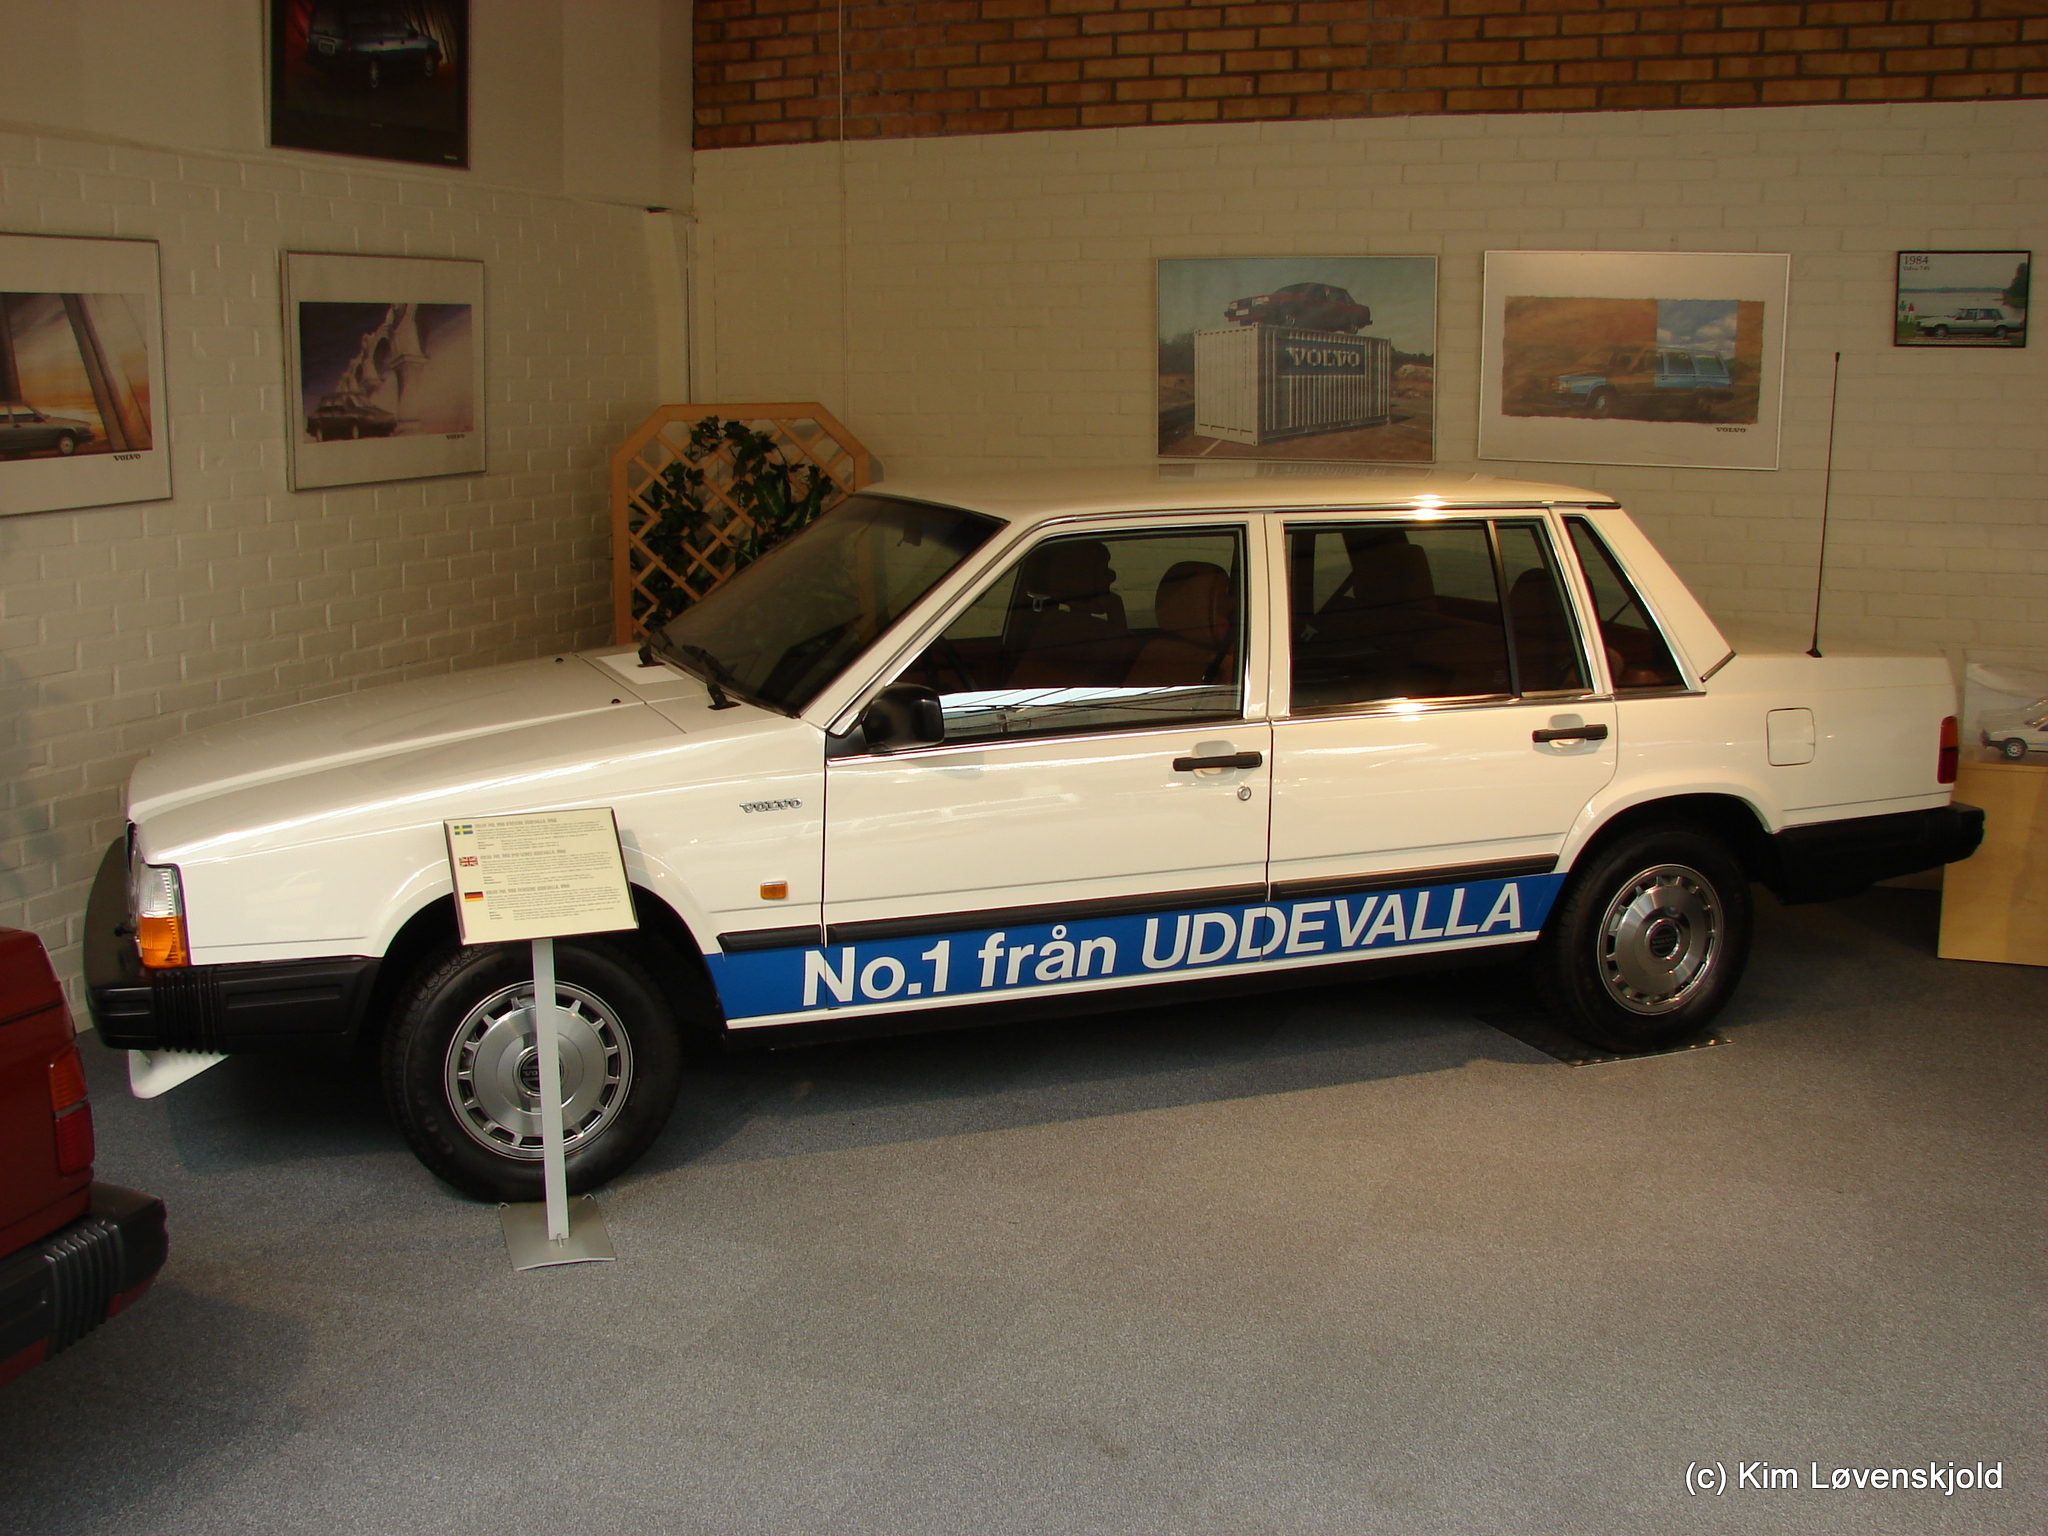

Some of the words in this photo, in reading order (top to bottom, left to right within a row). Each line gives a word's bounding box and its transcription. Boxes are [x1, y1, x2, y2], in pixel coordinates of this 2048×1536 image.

[1904, 255, 1928, 265] 1984
[1286, 346, 1360, 367] VOLVO
[113, 453, 141, 462] VOLVO
[739, 798, 803, 814] VOLVO
[803, 940, 950, 1006] No.1
[978, 925, 1118, 988] från
[1141, 882, 1521, 969] UDDEVALLA
